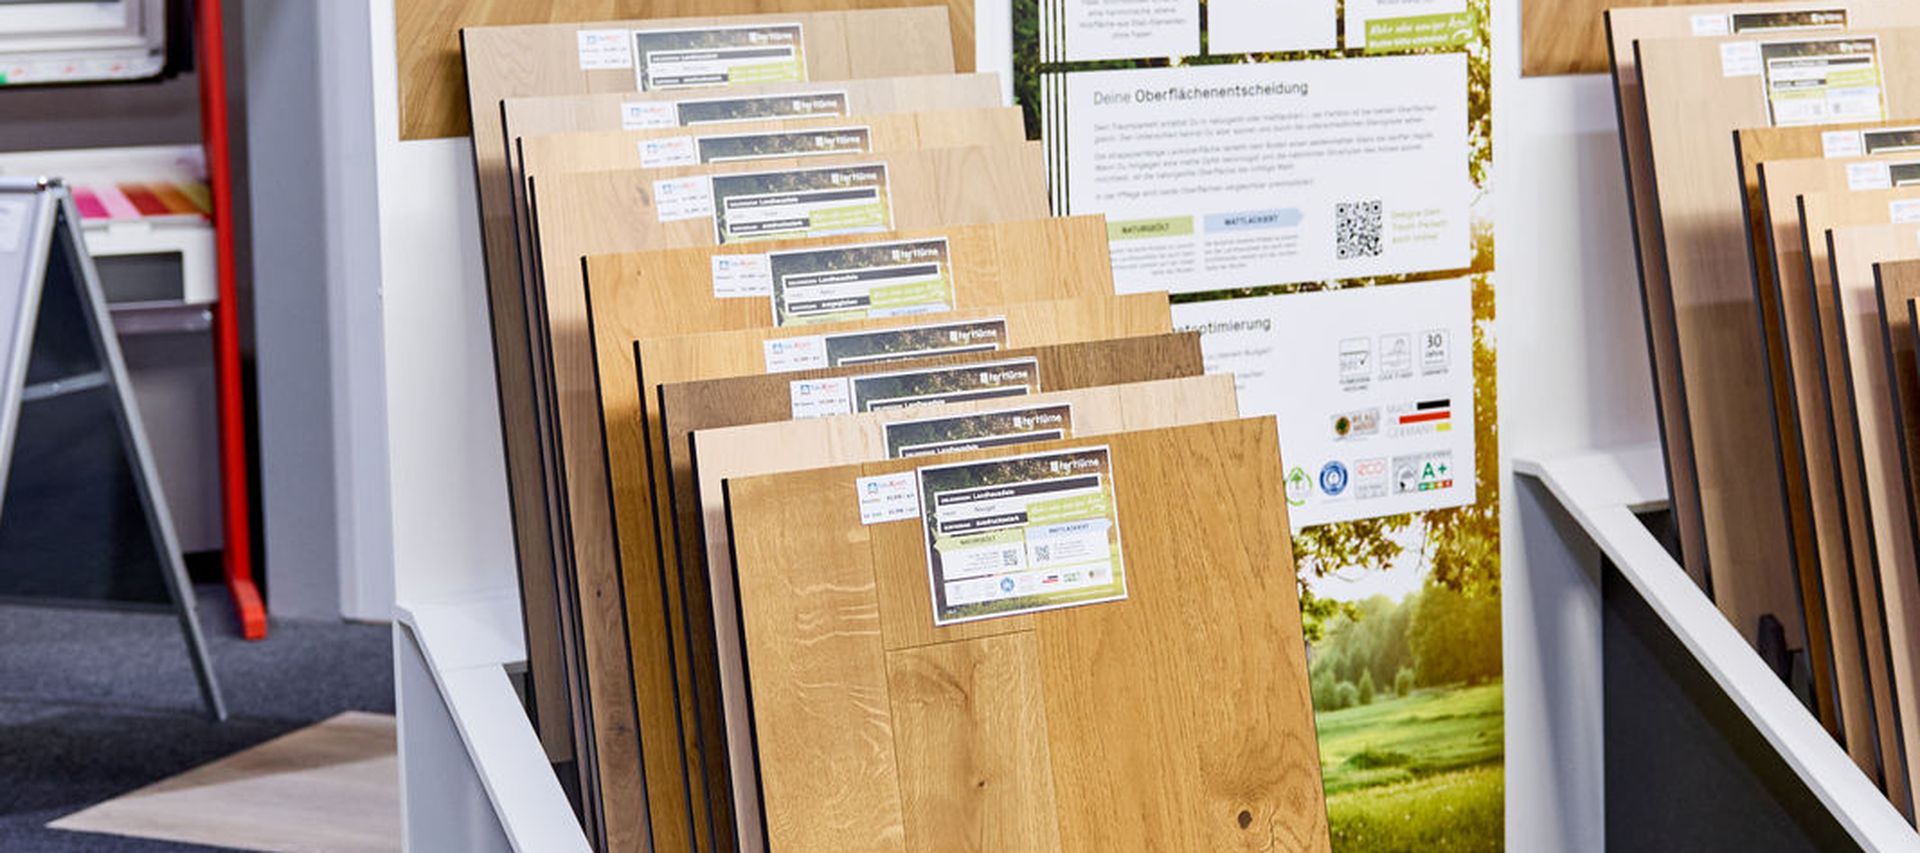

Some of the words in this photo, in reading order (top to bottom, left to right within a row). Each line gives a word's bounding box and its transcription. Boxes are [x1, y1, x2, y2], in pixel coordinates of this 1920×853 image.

[1093, 91, 1131, 105] Deine
[1135, 82, 1309, 103] Oberflächenentscheidung
[1427, 333, 1442, 348] 30
[1421, 461, 1448, 480] A+
